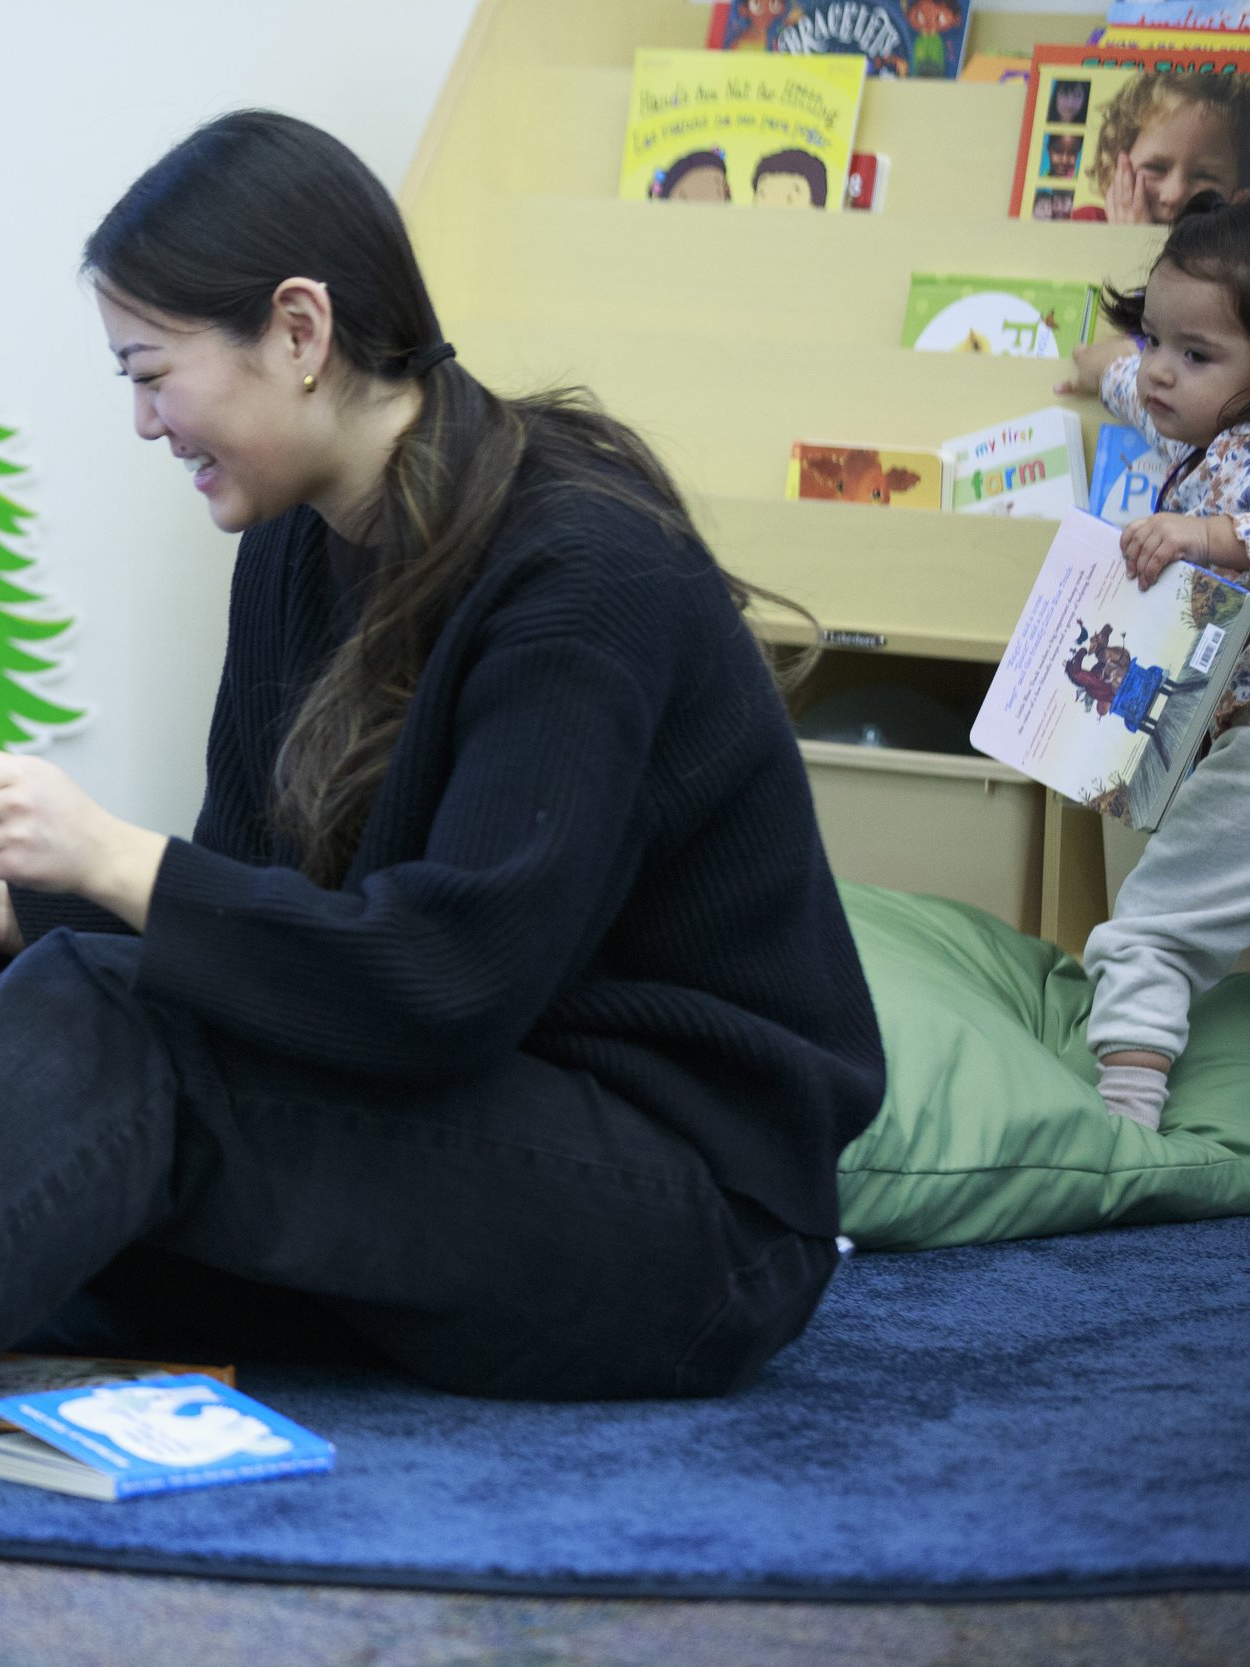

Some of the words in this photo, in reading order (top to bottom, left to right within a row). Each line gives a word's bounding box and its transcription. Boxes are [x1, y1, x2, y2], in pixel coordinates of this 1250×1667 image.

[975, 438, 996, 459] my
[1002, 426, 1034, 446] first
[972, 457, 1046, 501] farm
